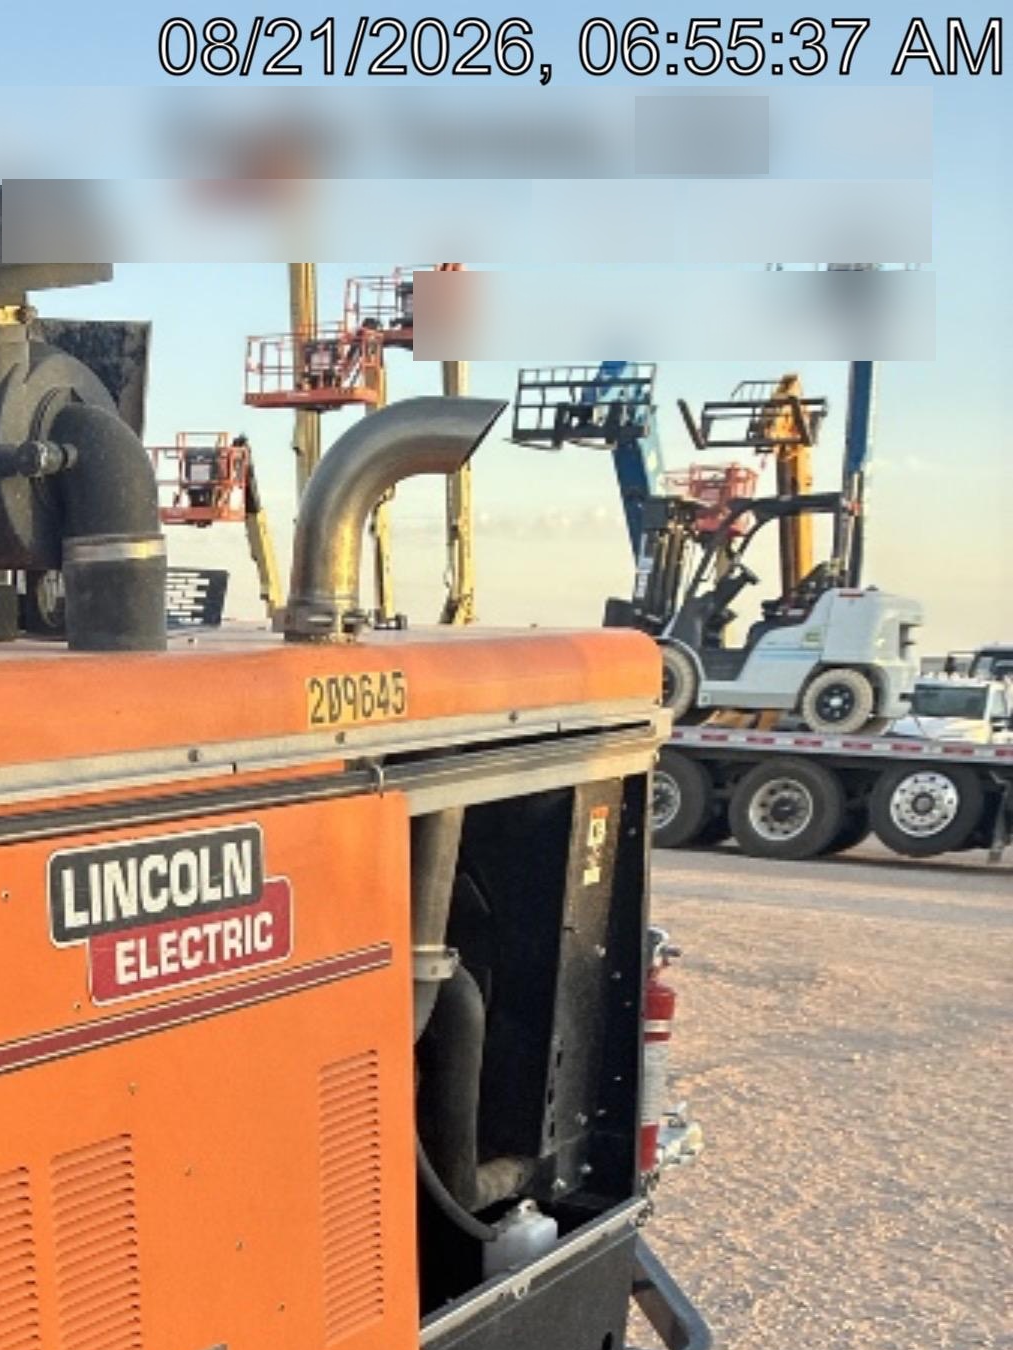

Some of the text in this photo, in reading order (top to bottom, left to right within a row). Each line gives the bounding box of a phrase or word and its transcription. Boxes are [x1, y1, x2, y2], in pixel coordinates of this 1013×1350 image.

[307, 671, 406, 724] 209645
[60, 838, 253, 929] LINCOLN
[114, 911, 274, 986] ELECTRIC
